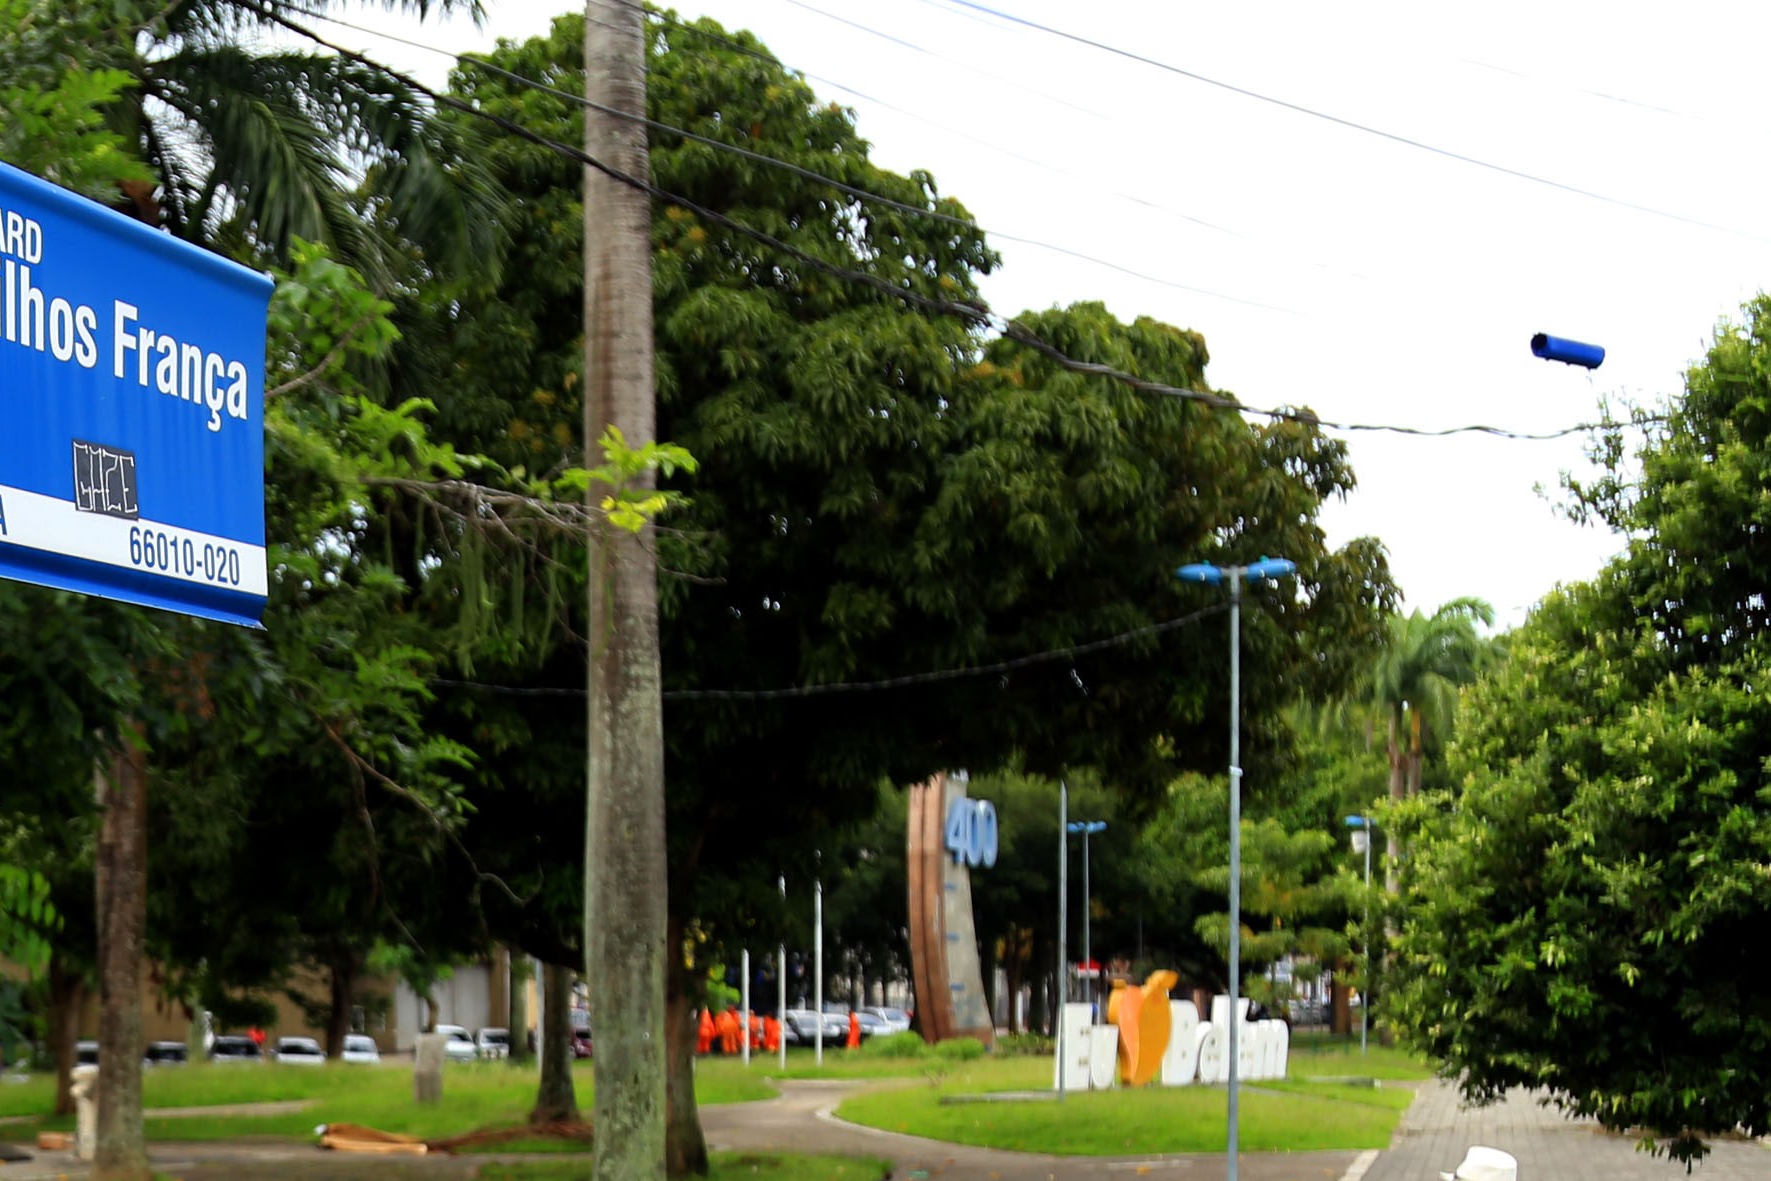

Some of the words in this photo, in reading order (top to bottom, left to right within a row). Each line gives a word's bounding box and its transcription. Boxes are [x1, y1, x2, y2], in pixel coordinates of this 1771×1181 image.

[113, 299, 248, 432] França
[129, 526, 240, 586] 66010-020
[946, 796, 999, 868] 400
